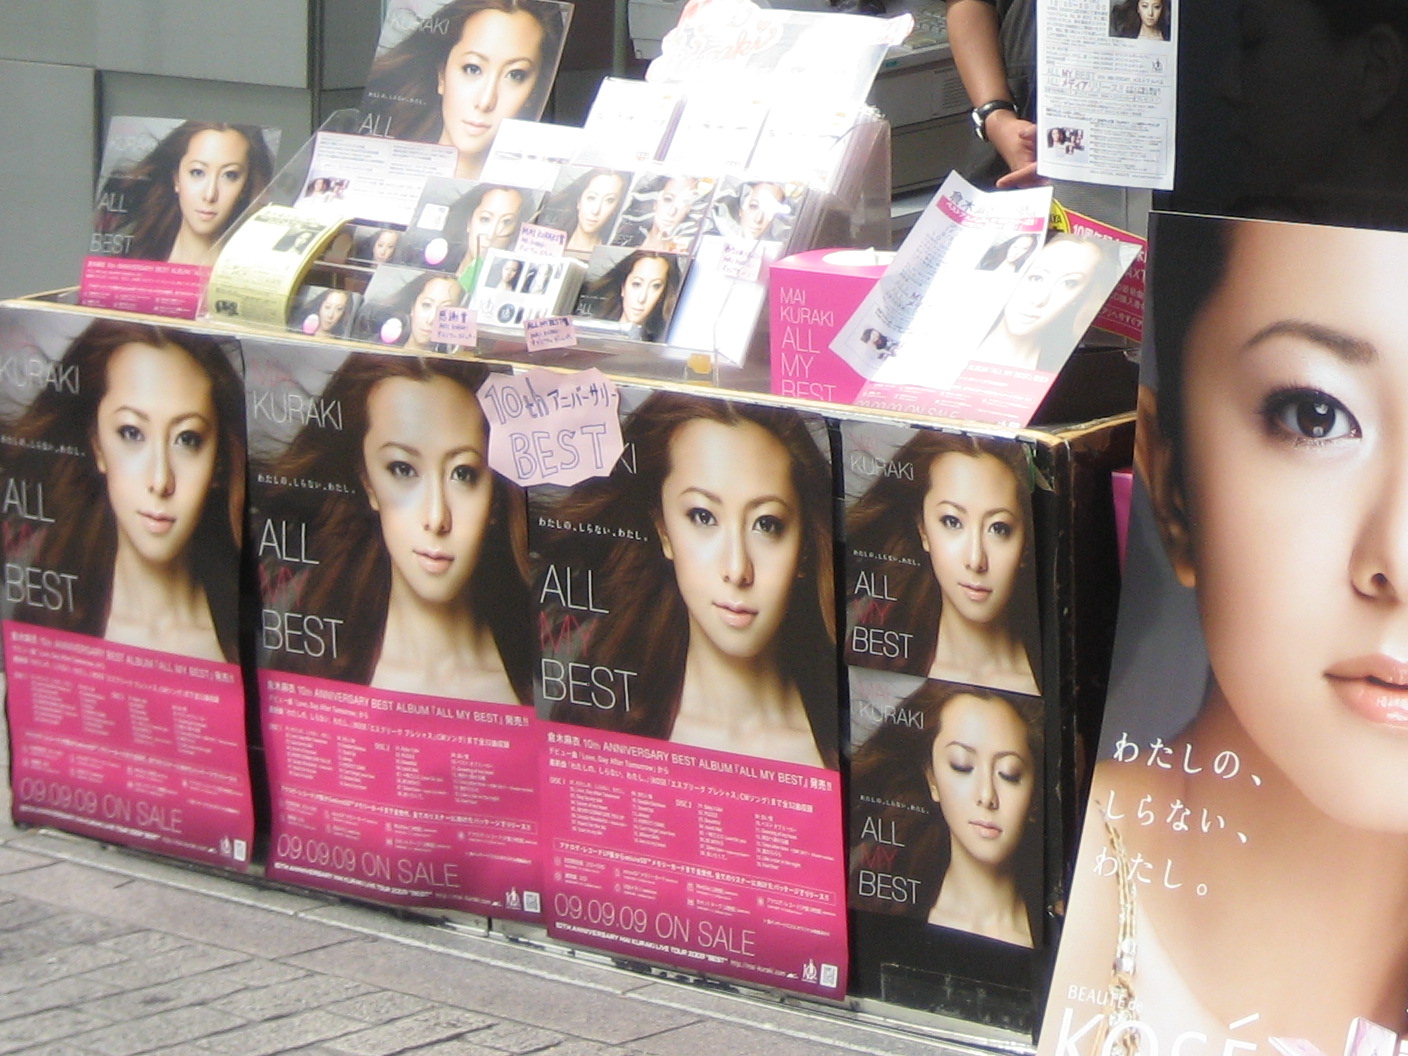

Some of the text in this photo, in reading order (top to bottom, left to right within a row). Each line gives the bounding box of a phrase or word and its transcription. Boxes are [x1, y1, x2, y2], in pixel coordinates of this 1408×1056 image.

[360, 113, 395, 139] ALL
[99, 193, 128, 214] ALL
[89, 233, 135, 255] BEST
[780, 287, 805, 305] MAI
[780, 306, 834, 327] KURAKI
[781, 326, 821, 354] ALL
[781, 354, 814, 379] MY
[252, 390, 343, 431] KURAKI
[485, 377, 617, 425] 10th アニバーサリー
[510, 423, 607, 480] BEST
[850, 457, 914, 481] KURAKI
[2, 477, 56, 523] ALL
[258, 518, 320, 565] ALL
[4, 563, 78, 613] BEST
[540, 564, 609, 615] ALL
[854, 570, 898, 602] ALL
[261, 609, 344, 659] BEST
[852, 626, 914, 659] BEST
[541, 658, 638, 713] BEST
[371, 698, 393, 712] BEST
[396, 702, 429, 716] ALBUM
[859, 699, 924, 729] KURAKI
[602, 742, 669, 766] ANNIVERSARY
[671, 755, 696, 769] BEST
[699, 759, 733, 775] ALBUM
[760, 768, 775, 782] MY
[1114, 731, 1262, 787] わたしの、
[103, 793, 130, 823] ON
[137, 801, 182, 834] SALE
[861, 816, 905, 847] ALL
[1105, 789, 1248, 844] しらない、
[276, 832, 461, 889] 09.09.09 ON SALE
[1093, 846, 1208, 896] わたし。
[858, 870, 921, 905] BEST
[554, 893, 756, 957] 09.09.09 ON SALE
